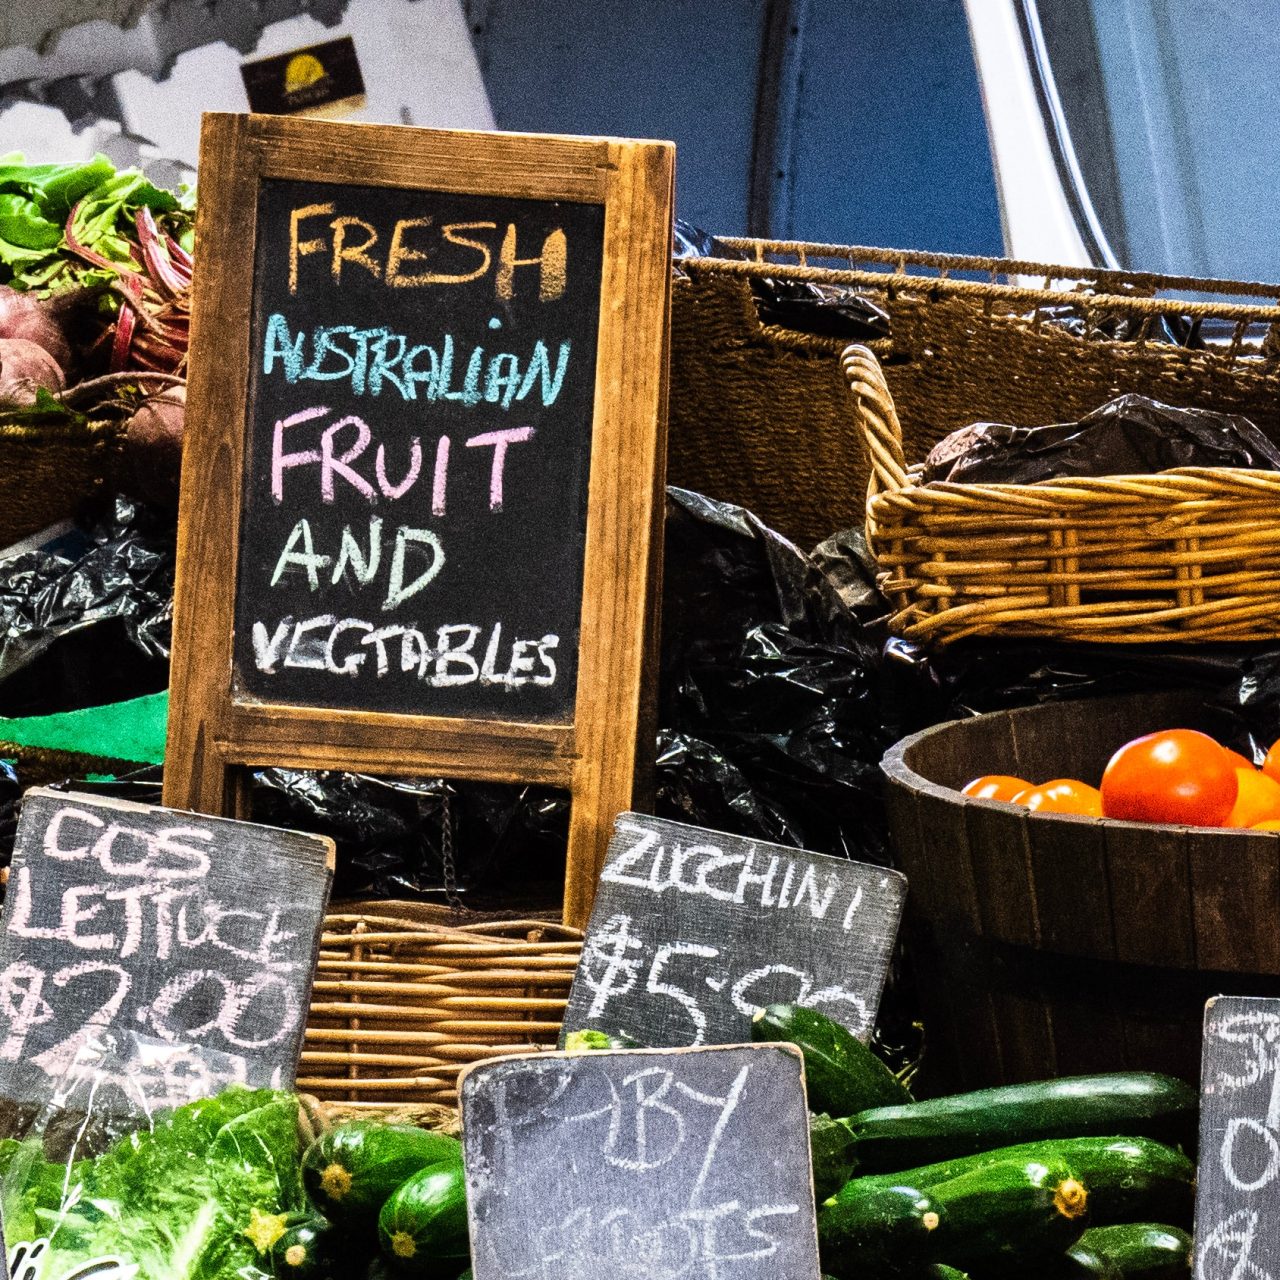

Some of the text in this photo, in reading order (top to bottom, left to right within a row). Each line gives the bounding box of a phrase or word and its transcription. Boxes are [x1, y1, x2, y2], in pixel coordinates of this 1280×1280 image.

[289, 202, 567, 301] FRESH
[271, 405, 535, 516] FRUIT
[270, 515, 446, 611] AND
[44, 807, 213, 878] COS
